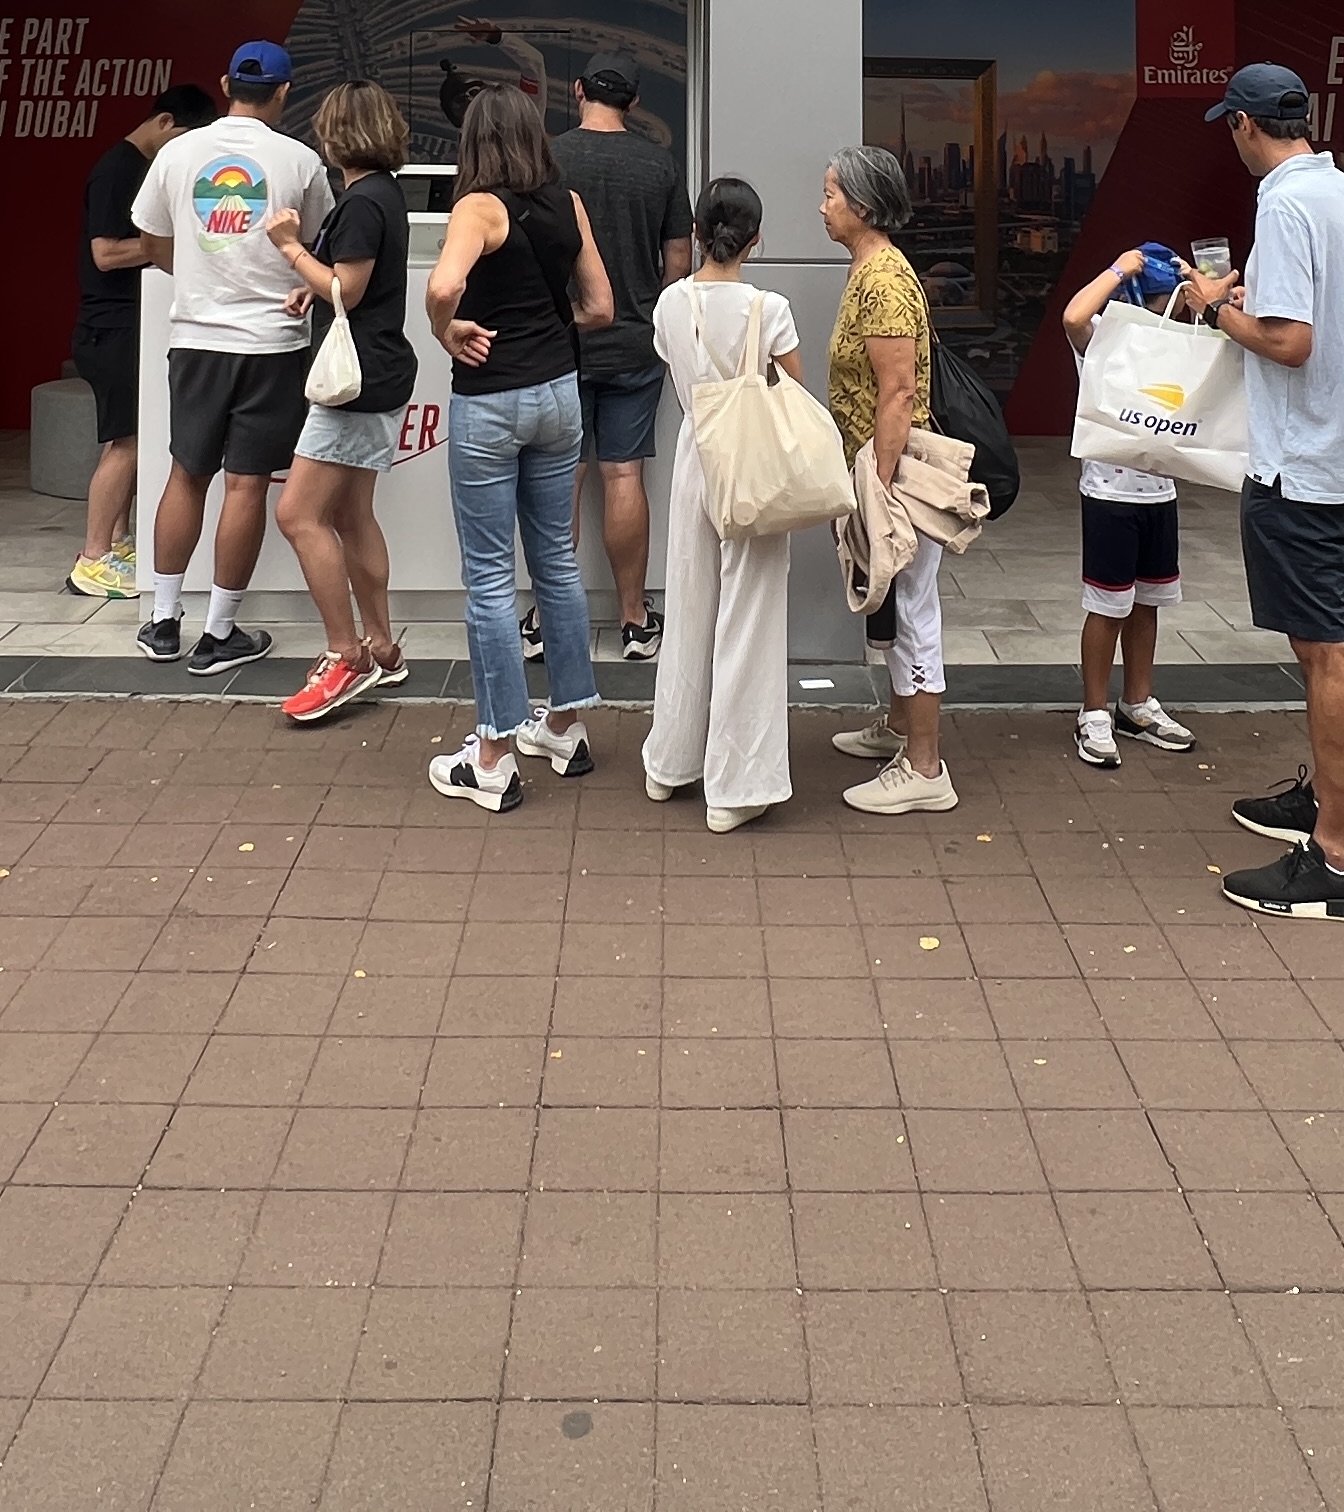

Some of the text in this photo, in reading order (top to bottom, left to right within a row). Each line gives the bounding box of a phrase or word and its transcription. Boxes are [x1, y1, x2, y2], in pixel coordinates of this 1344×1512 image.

[20, 17, 90, 55] PART
[20, 58, 69, 97] THE
[73, 58, 173, 97] ACTION
[1143, 65, 1229, 84] Emirates
[14, 100, 99, 138] DUBAI
[206, 210, 254, 234] NIKE
[1119, 407, 1198, 436] us open
